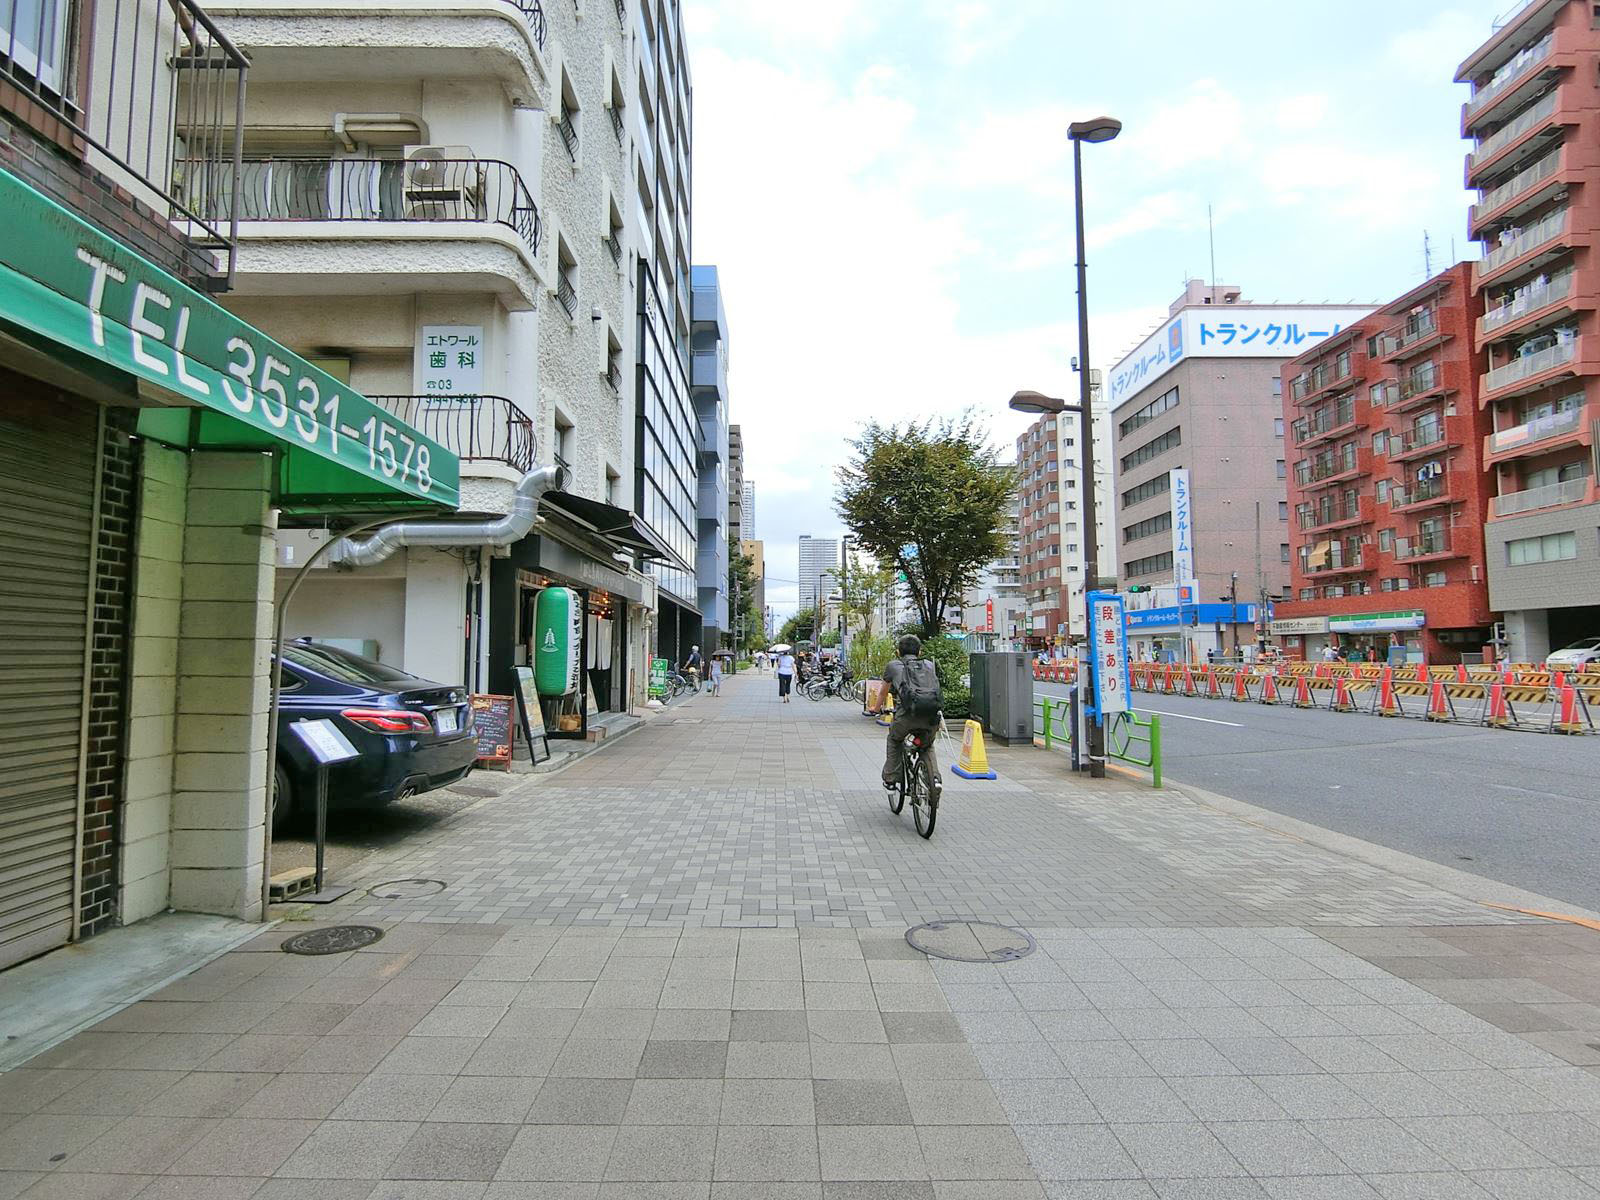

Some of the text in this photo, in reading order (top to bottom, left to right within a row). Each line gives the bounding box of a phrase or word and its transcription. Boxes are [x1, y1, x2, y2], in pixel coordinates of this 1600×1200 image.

[76, 247, 433, 493] TEL 3531-1578
[427, 335, 479, 346] エトワール
[1111, 344, 1166, 399] トランクルーム
[1176, 478, 1188, 552] トランクルーム
[1102, 605, 1117, 692] 段差あり
